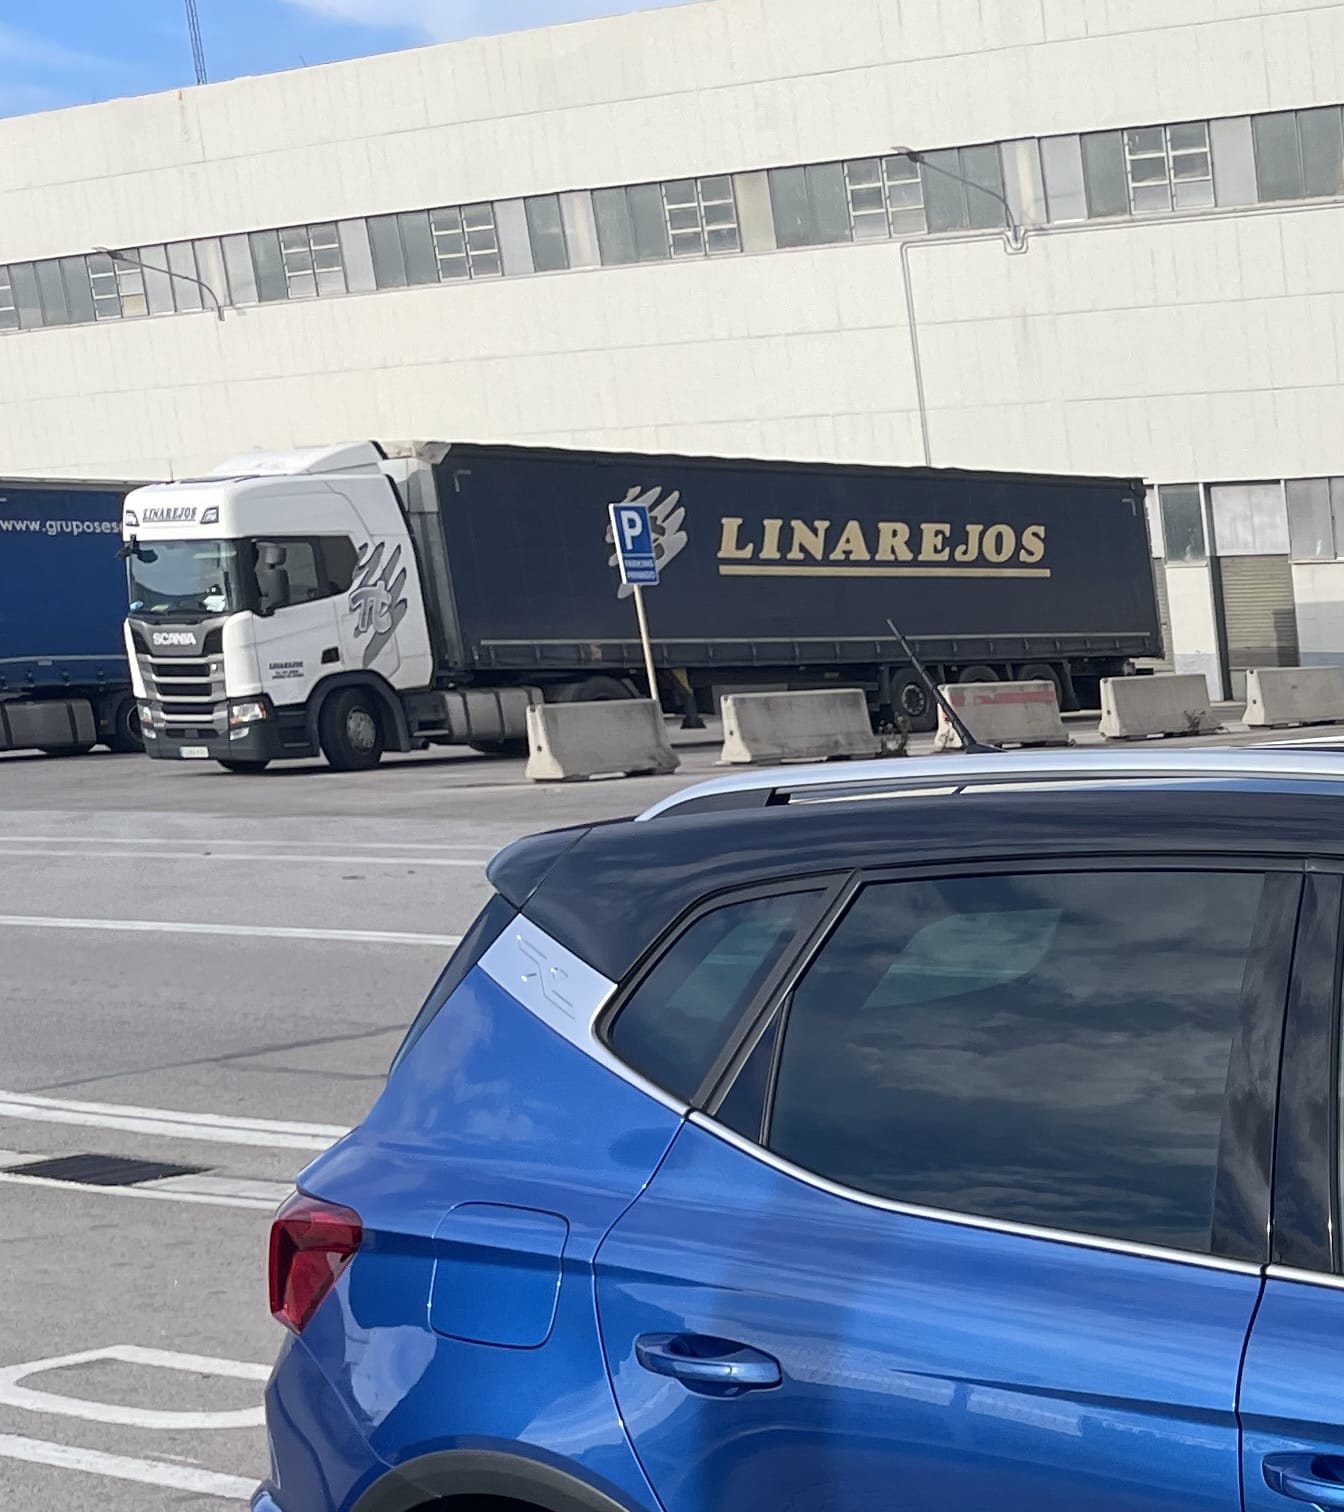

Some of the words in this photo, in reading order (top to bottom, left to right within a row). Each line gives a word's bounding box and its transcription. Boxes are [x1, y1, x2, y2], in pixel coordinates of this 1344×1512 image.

[142, 507, 197, 521] LINAREJOS
[621, 510, 643, 550] P
[716, 517, 1046, 563] LINAREJOS
[152, 632, 197, 646] SCANIA
